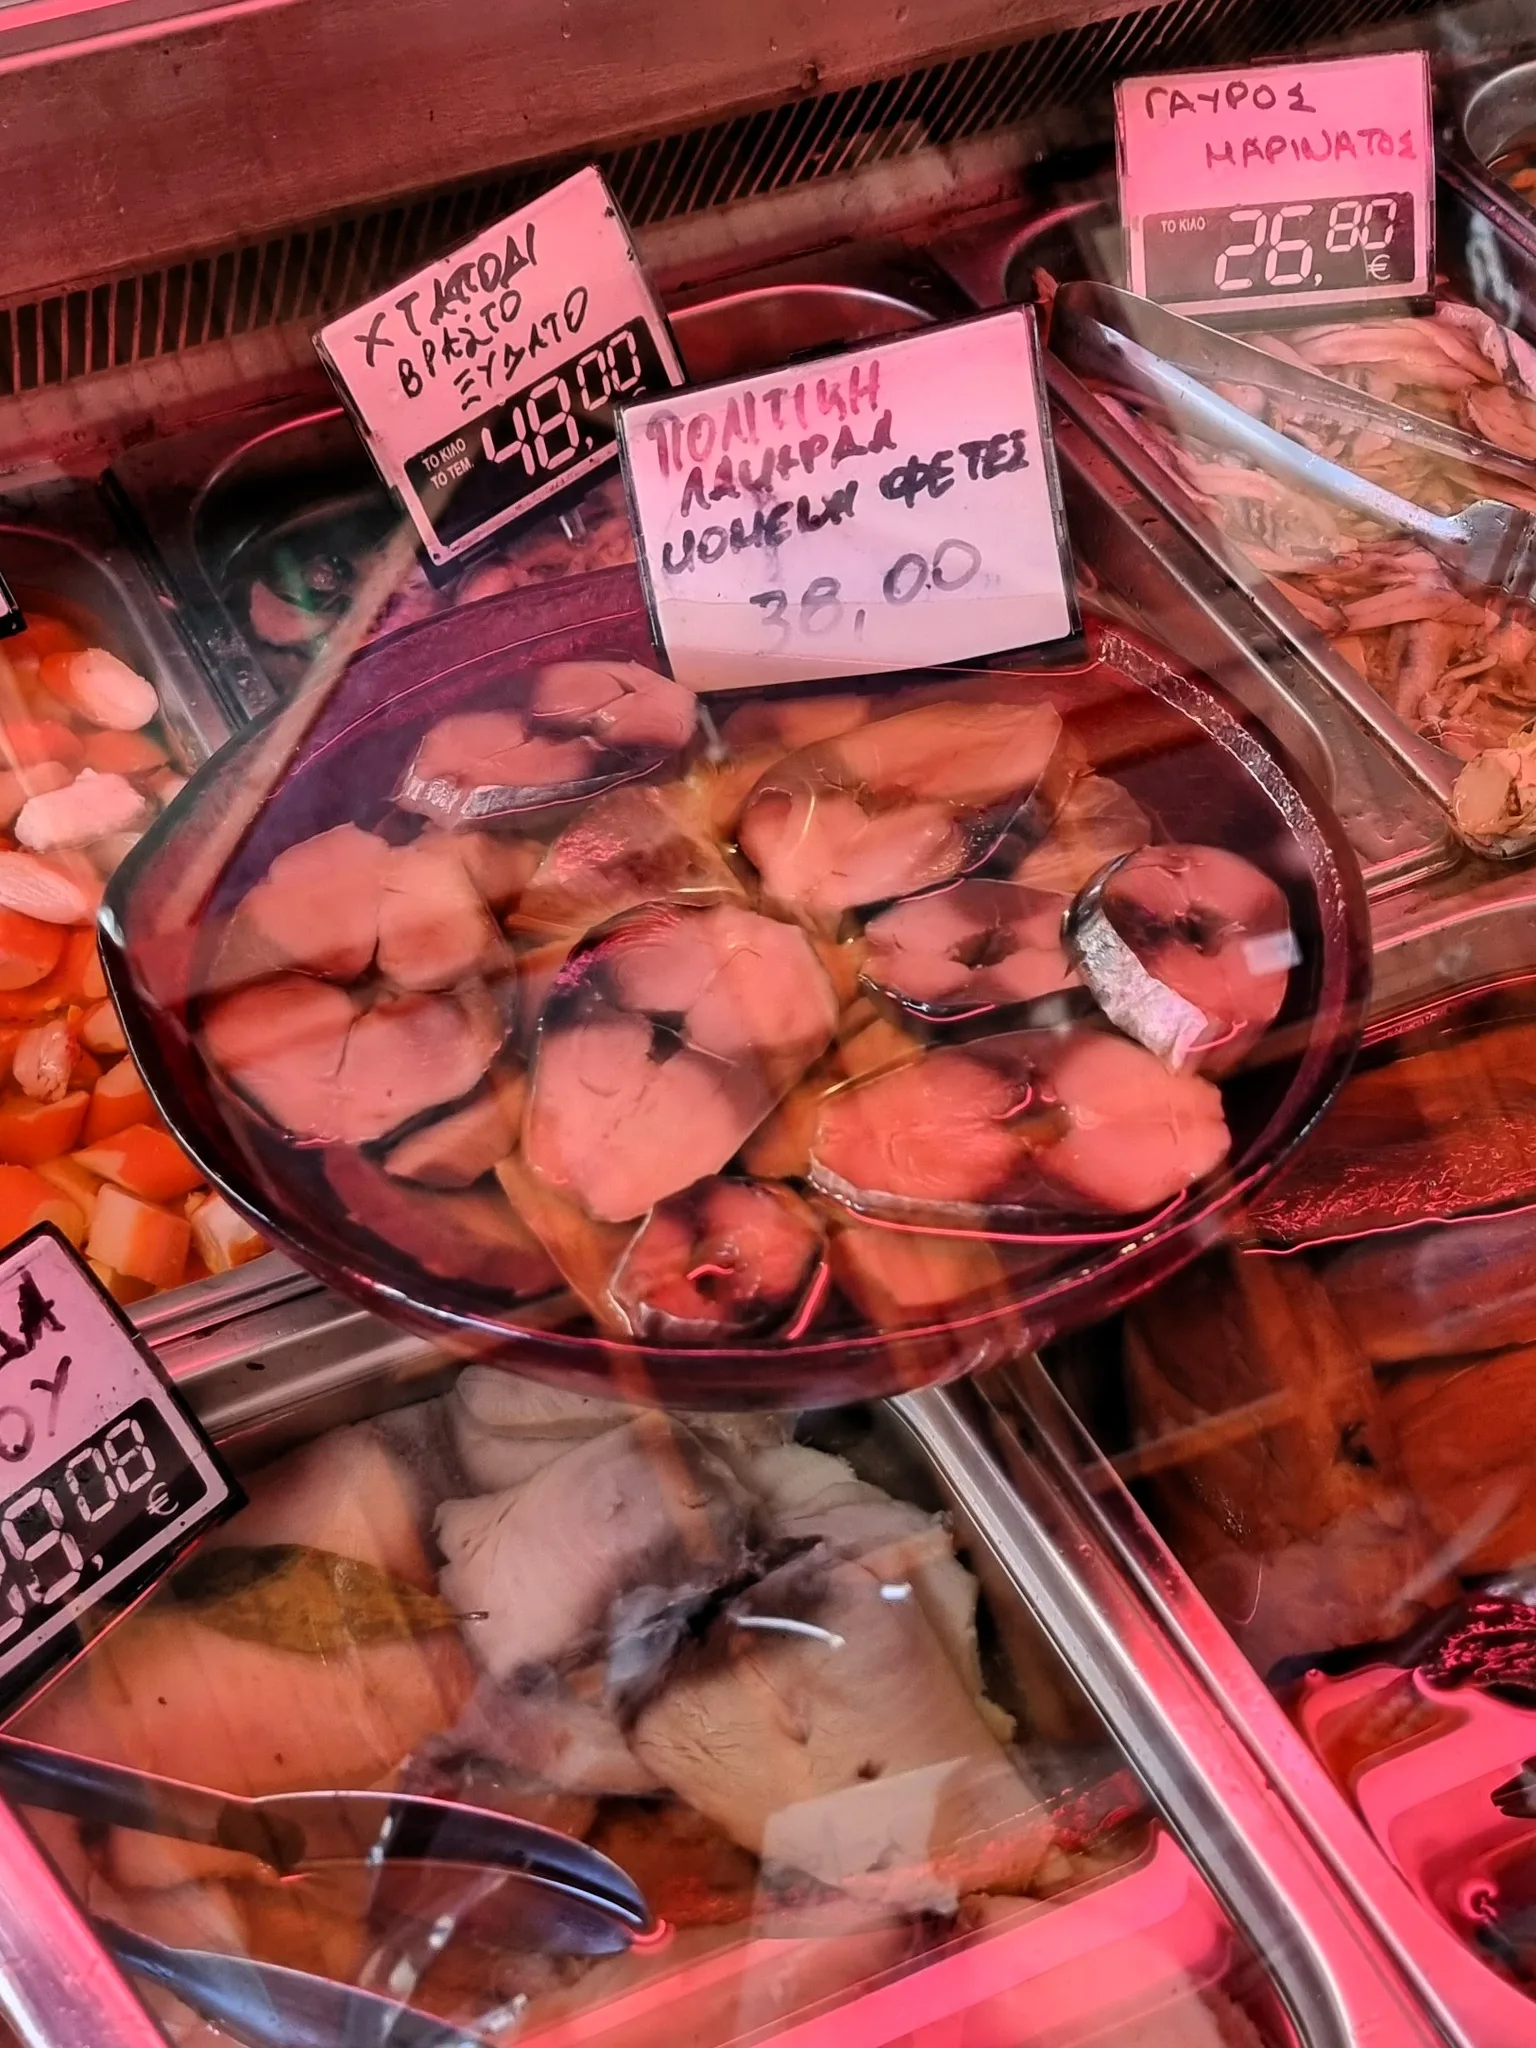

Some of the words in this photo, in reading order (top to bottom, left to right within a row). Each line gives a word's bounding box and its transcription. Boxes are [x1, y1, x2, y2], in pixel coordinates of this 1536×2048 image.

[1145, 81, 1316, 119] ΓΑΥΡΟΣ
[1205, 128, 1417, 168] ΜΑΡΙΝΑΤΟΣ
[1161, 220, 1177, 233] ΤΟ
[1179, 217, 1206, 232] ΚΙΛΟ
[1367, 254, 1391, 281] €
[398, 290, 521, 399] ΒΡΑΣΤΟ
[453, 286, 588, 411] ΞΥΔΑΤΟ
[422, 455, 440, 472] ΤΟ
[439, 438, 466, 462] ΚΙΛΟ
[430, 471, 448, 490] ΤΟ
[146, 1481, 179, 1516] €
